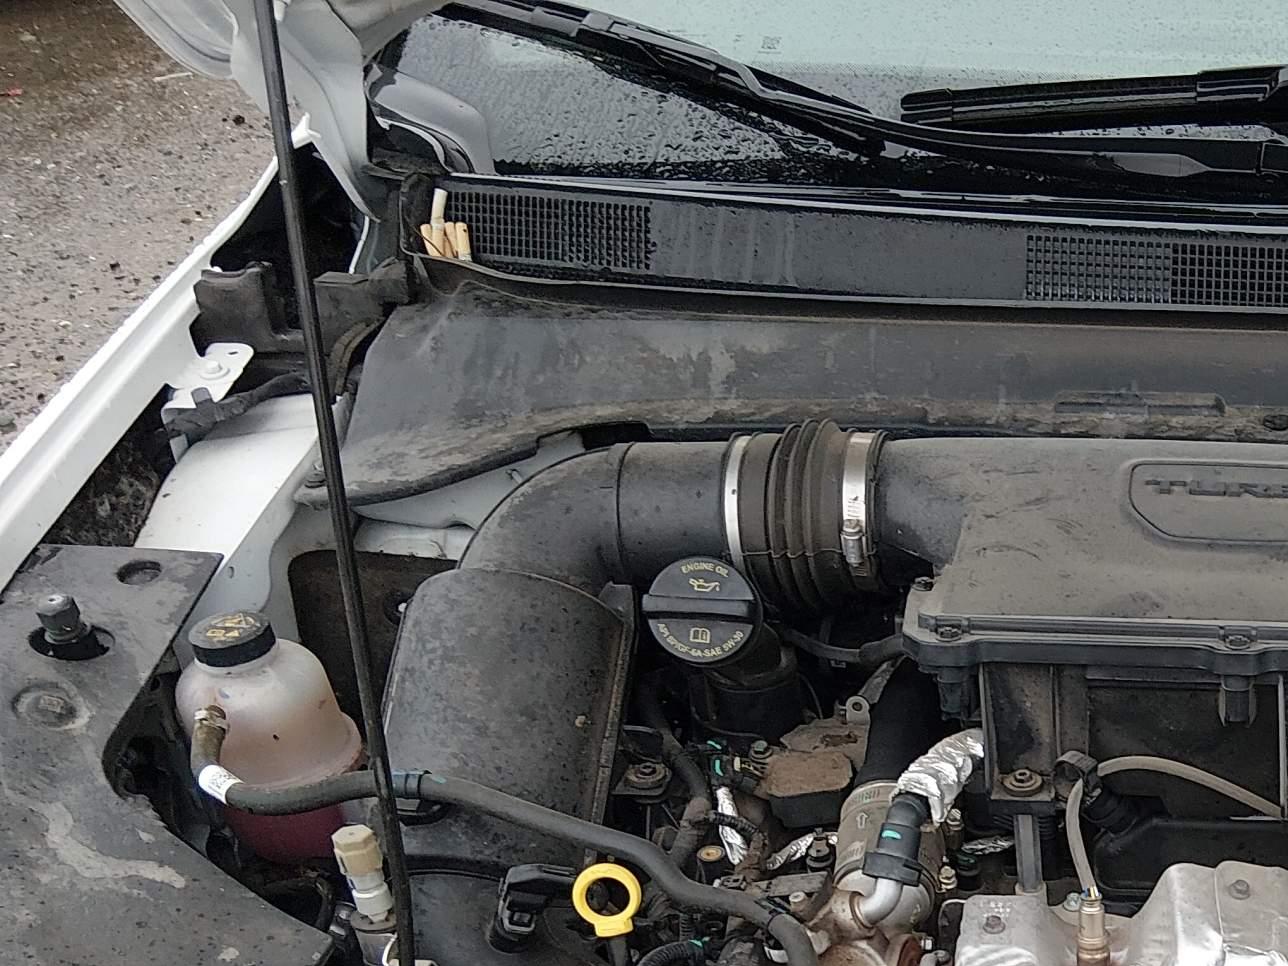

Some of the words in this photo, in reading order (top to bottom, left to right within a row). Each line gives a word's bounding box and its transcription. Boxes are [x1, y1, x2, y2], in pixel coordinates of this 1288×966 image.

[680, 562, 715, 574] ENGINE
[715, 566, 729, 578] OIL
[657, 623, 672, 638] API
[702, 646, 722, 658] SAE
